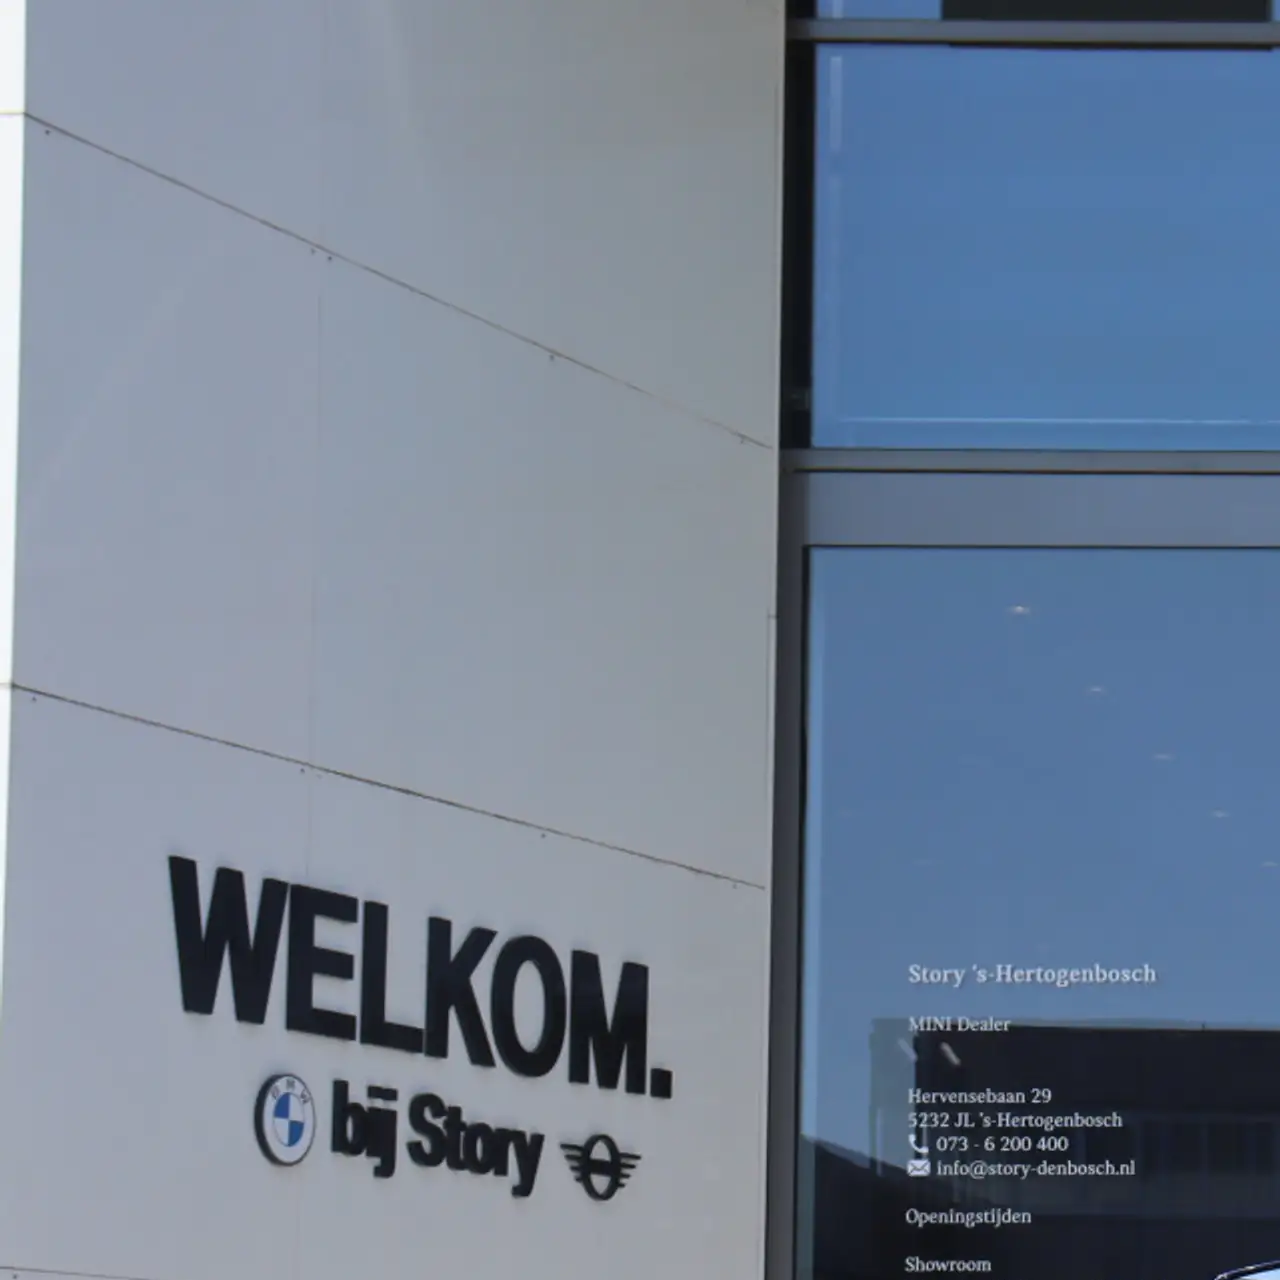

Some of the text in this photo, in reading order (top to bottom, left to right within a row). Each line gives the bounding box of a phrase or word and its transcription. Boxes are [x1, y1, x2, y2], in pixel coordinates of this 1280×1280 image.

[167, 854, 674, 1099] WELKOM.
[909, 963, 1155, 987] Story 's-Hertogenbosch
[909, 1018, 1011, 1032] MINI Dealer
[908, 1088, 1051, 1104] Hervensebaan 29
[908, 1112, 1122, 1131] 5232 JL 's-Hertogenbosch
[330, 1078, 544, 1198] bij Story
[936, 1136, 968, 1151] 073
[984, 1137, 995, 1151] 6
[1001, 1137, 1031, 1151] 200
[1037, 1137, 1068, 1151] 400
[937, 1160, 1134, 1179] info@story-denbosch.nl
[906, 1208, 1031, 1227] Openingstijden
[906, 1257, 991, 1271] Showroom
